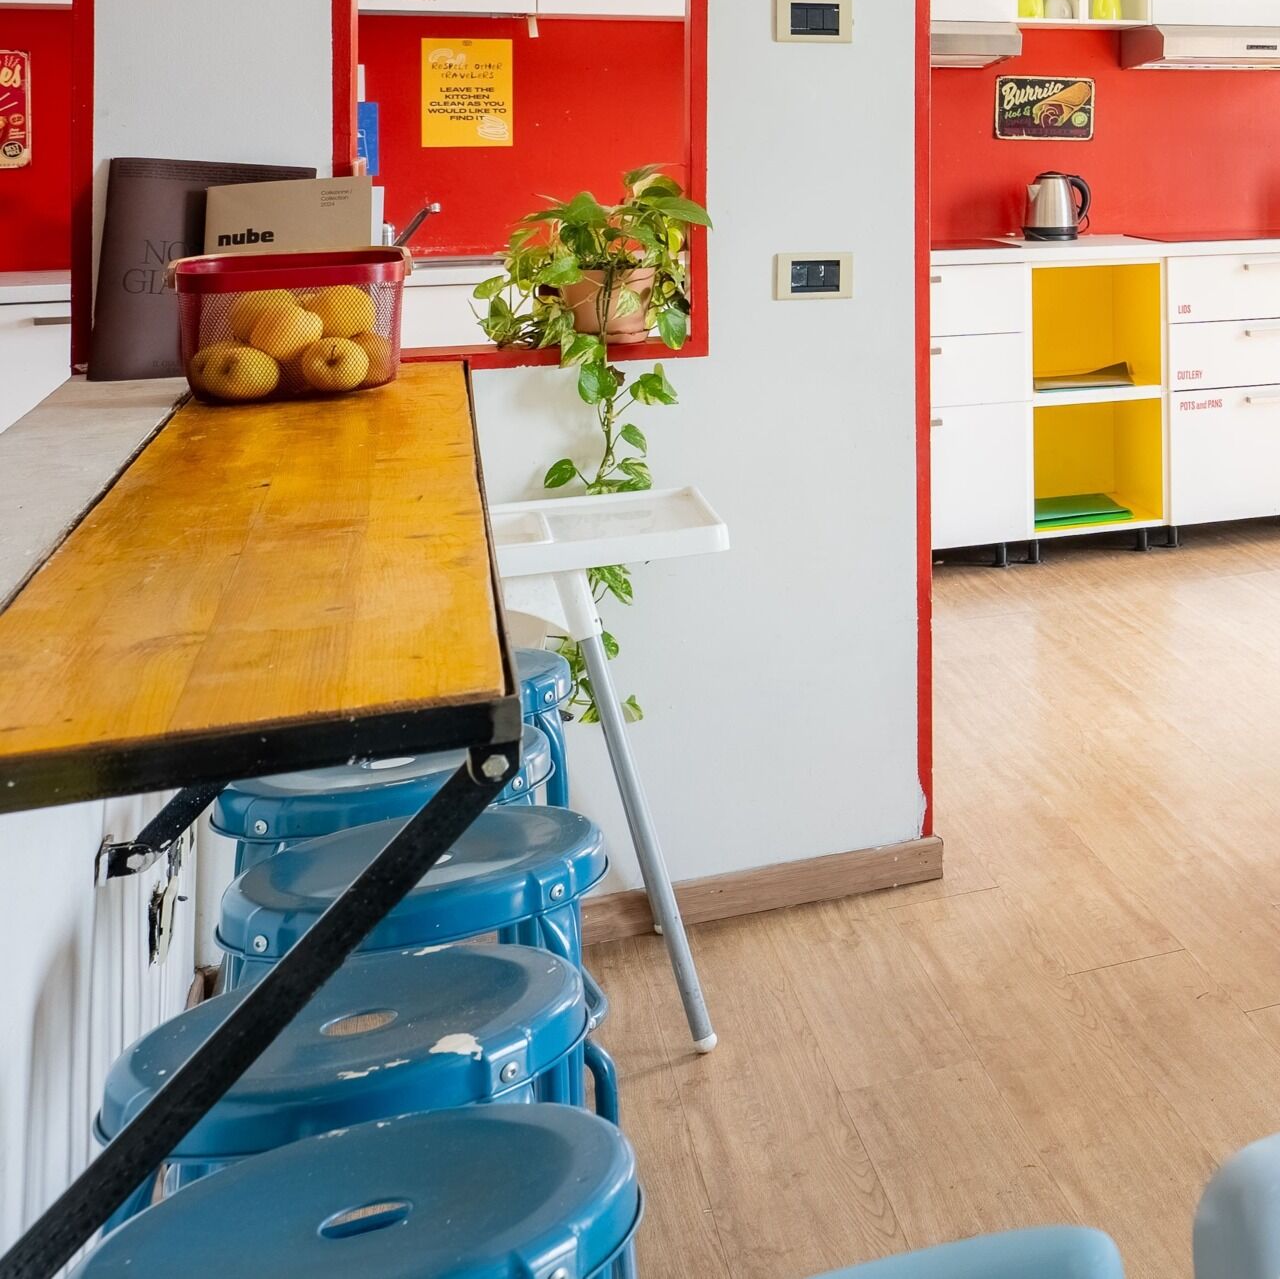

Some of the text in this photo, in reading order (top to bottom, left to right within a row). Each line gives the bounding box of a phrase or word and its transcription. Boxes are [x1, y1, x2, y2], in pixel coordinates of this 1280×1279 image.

[1002, 82, 1064, 109] Burrito
[218, 228, 275, 247] nube
[1178, 304, 1191, 314] LIDS
[1177, 370, 1203, 380] CUTLERY
[1180, 399, 1223, 411] POTS and PANS
